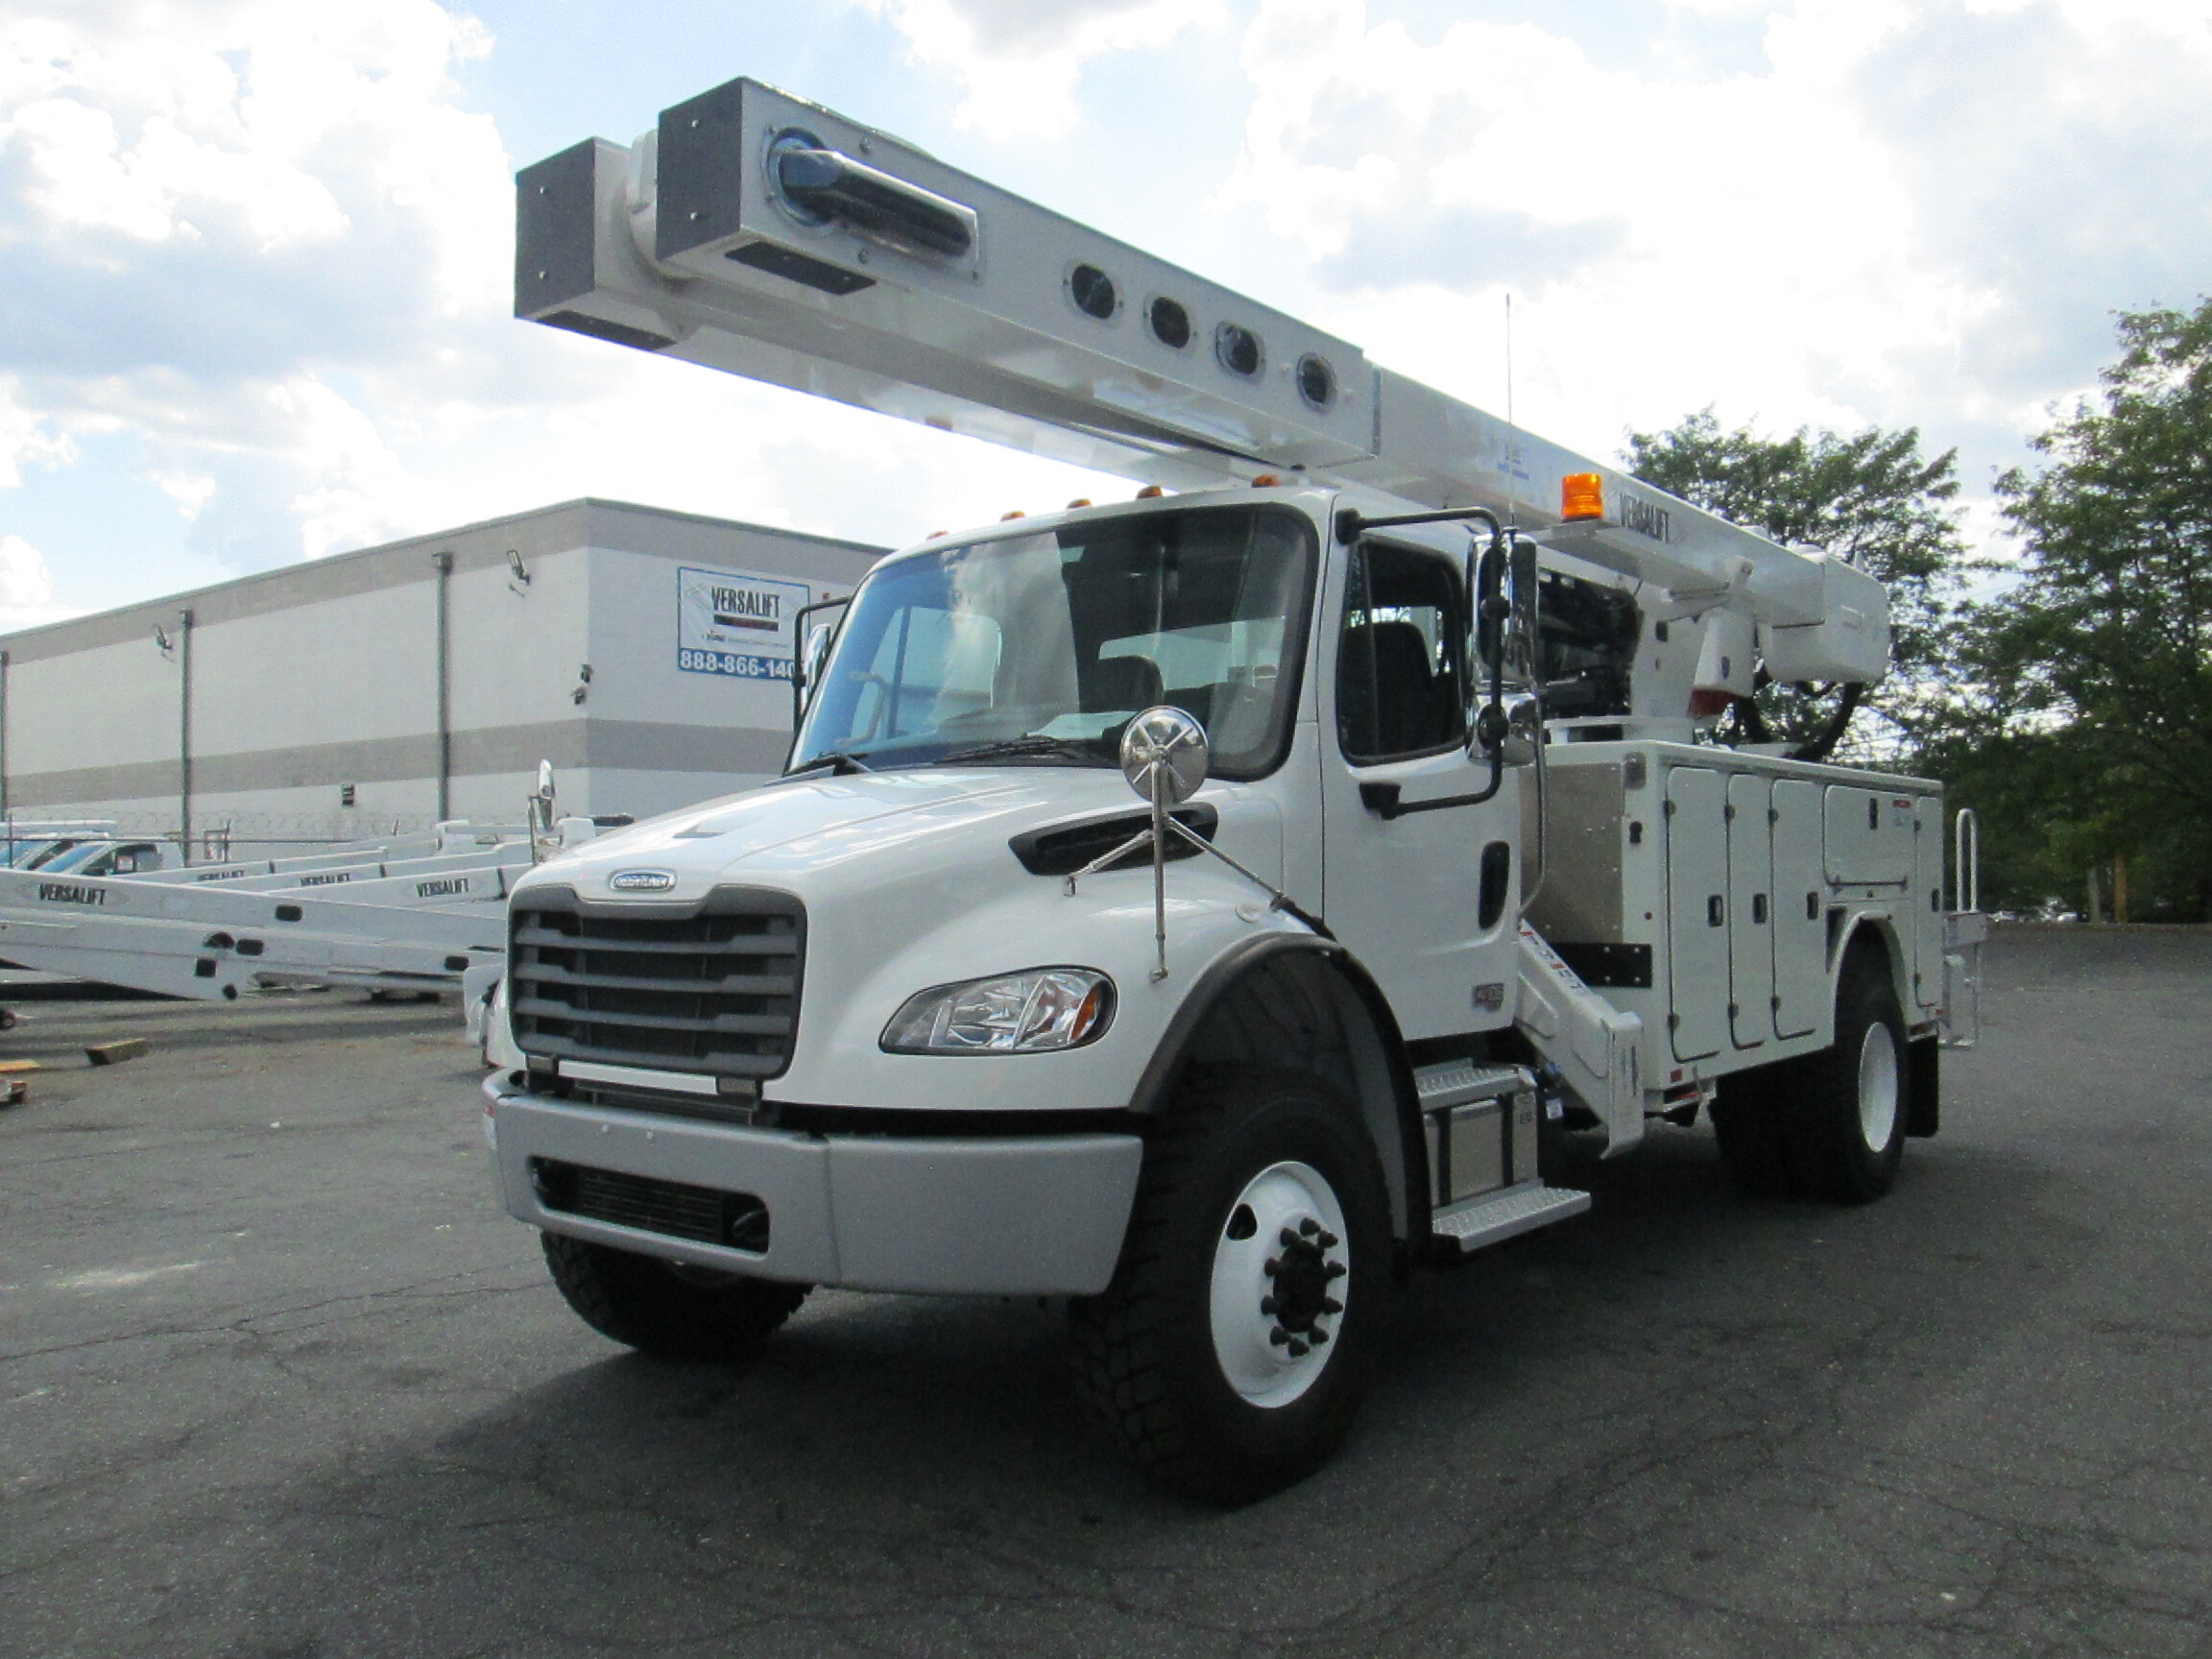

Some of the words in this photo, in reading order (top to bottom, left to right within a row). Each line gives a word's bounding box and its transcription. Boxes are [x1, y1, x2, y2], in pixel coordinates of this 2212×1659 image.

[711, 587, 781, 617] VERSALIFT
[39, 883, 106, 905] VERSALIFT
[416, 878, 469, 897] VERSALIFT
